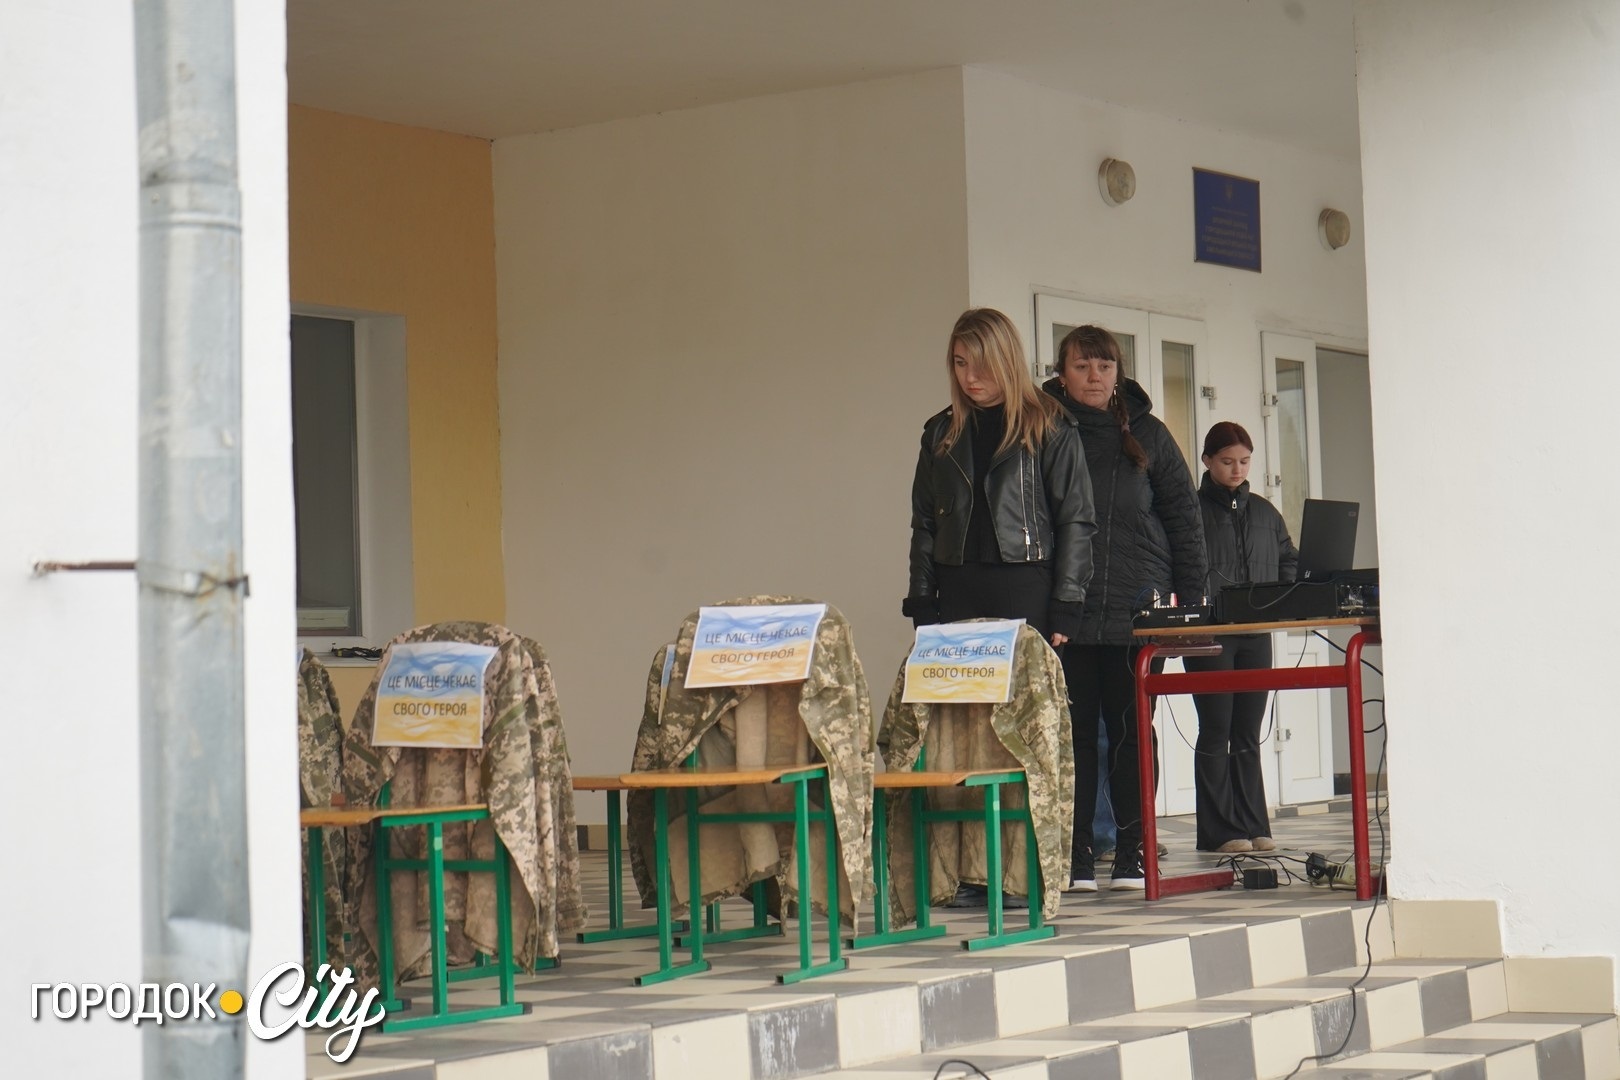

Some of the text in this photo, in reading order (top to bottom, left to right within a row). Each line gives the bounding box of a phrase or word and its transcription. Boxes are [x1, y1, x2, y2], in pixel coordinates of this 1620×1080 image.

[705, 625, 808, 645] ЦЕ МІСЦЕ ЧЕКАЄ
[711, 647, 795, 664] СВОГО ГЕРОЯ
[918, 645, 1007, 659] ЦЕ МІСЦЕ ЧЕКАЄ
[922, 667, 995, 679] СВОГО ГЕРОЯ
[387, 674, 477, 691] ЦЕ МІСЦЕ ЧЕКАЄ
[393, 703, 467, 716] СВОГО ГЕРОЯ
